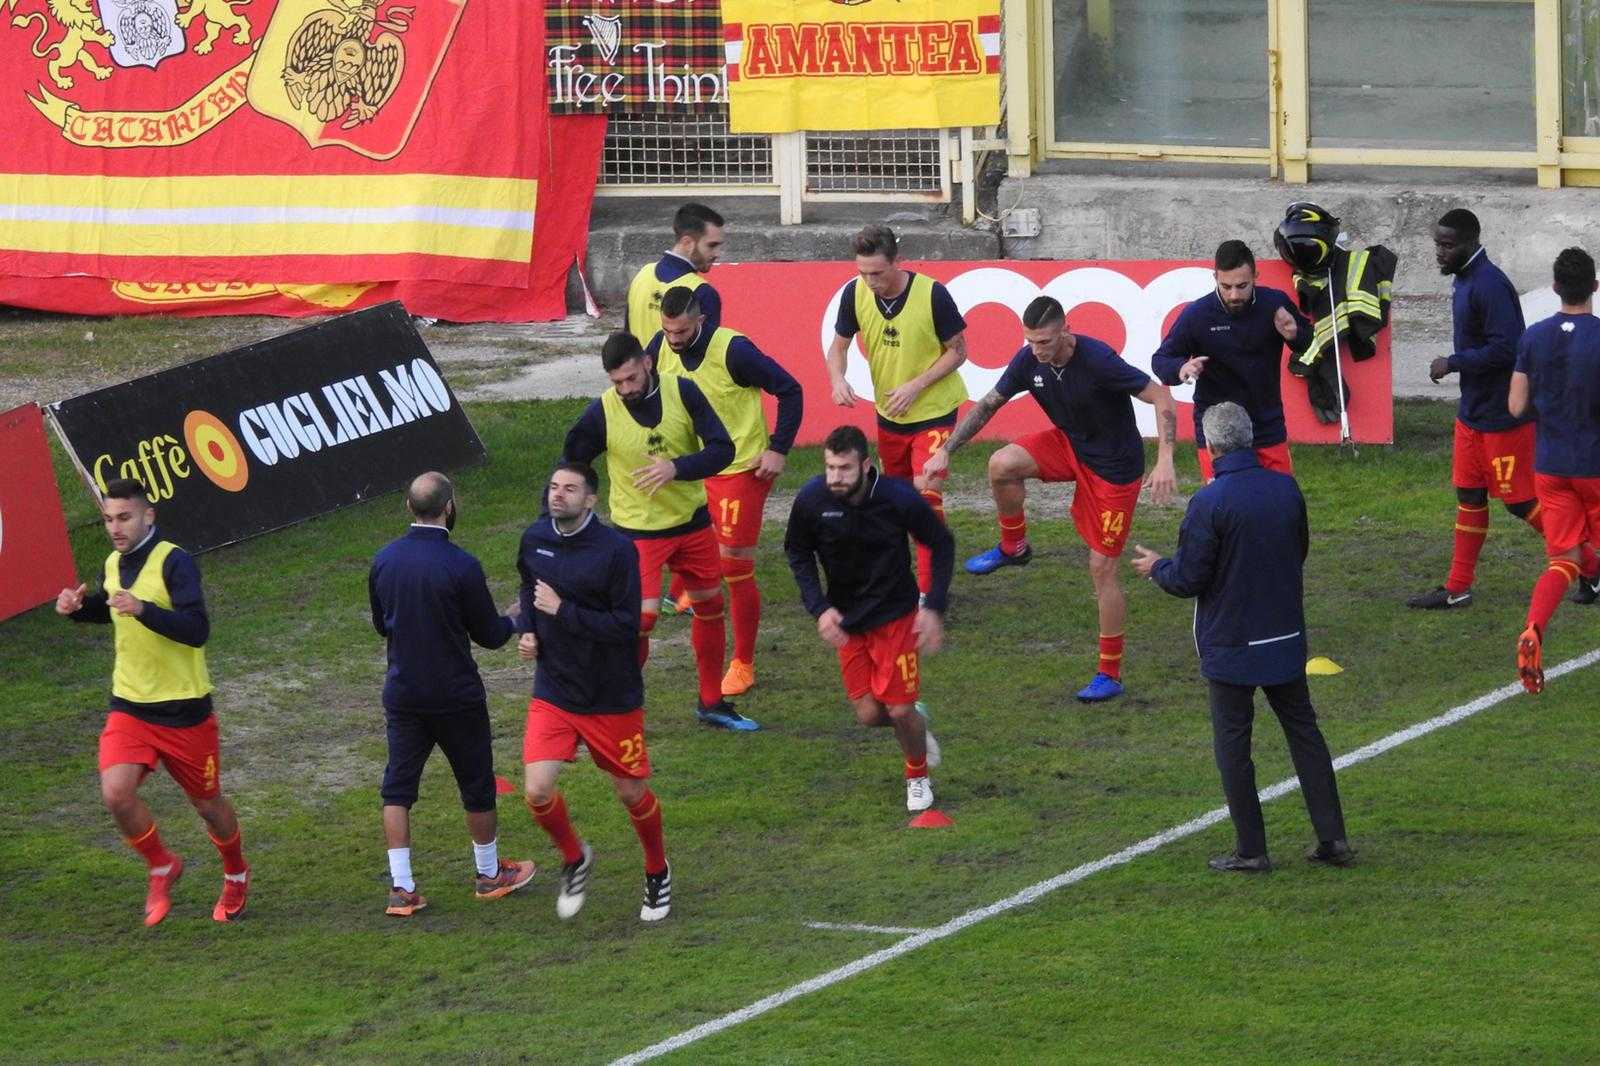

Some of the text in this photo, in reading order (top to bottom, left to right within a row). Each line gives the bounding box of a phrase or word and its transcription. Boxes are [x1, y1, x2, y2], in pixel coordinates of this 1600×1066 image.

[744, 20, 982, 78] AMANTEA
[549, 43, 626, 107] Free
[94, 357, 452, 503] Caffè GUGLIELMO
[1491, 455, 1515, 481] 17
[719, 498, 740, 525] 11
[1101, 510, 1124, 536] 14
[896, 652, 917, 681] 13
[620, 733, 642, 763] 23
